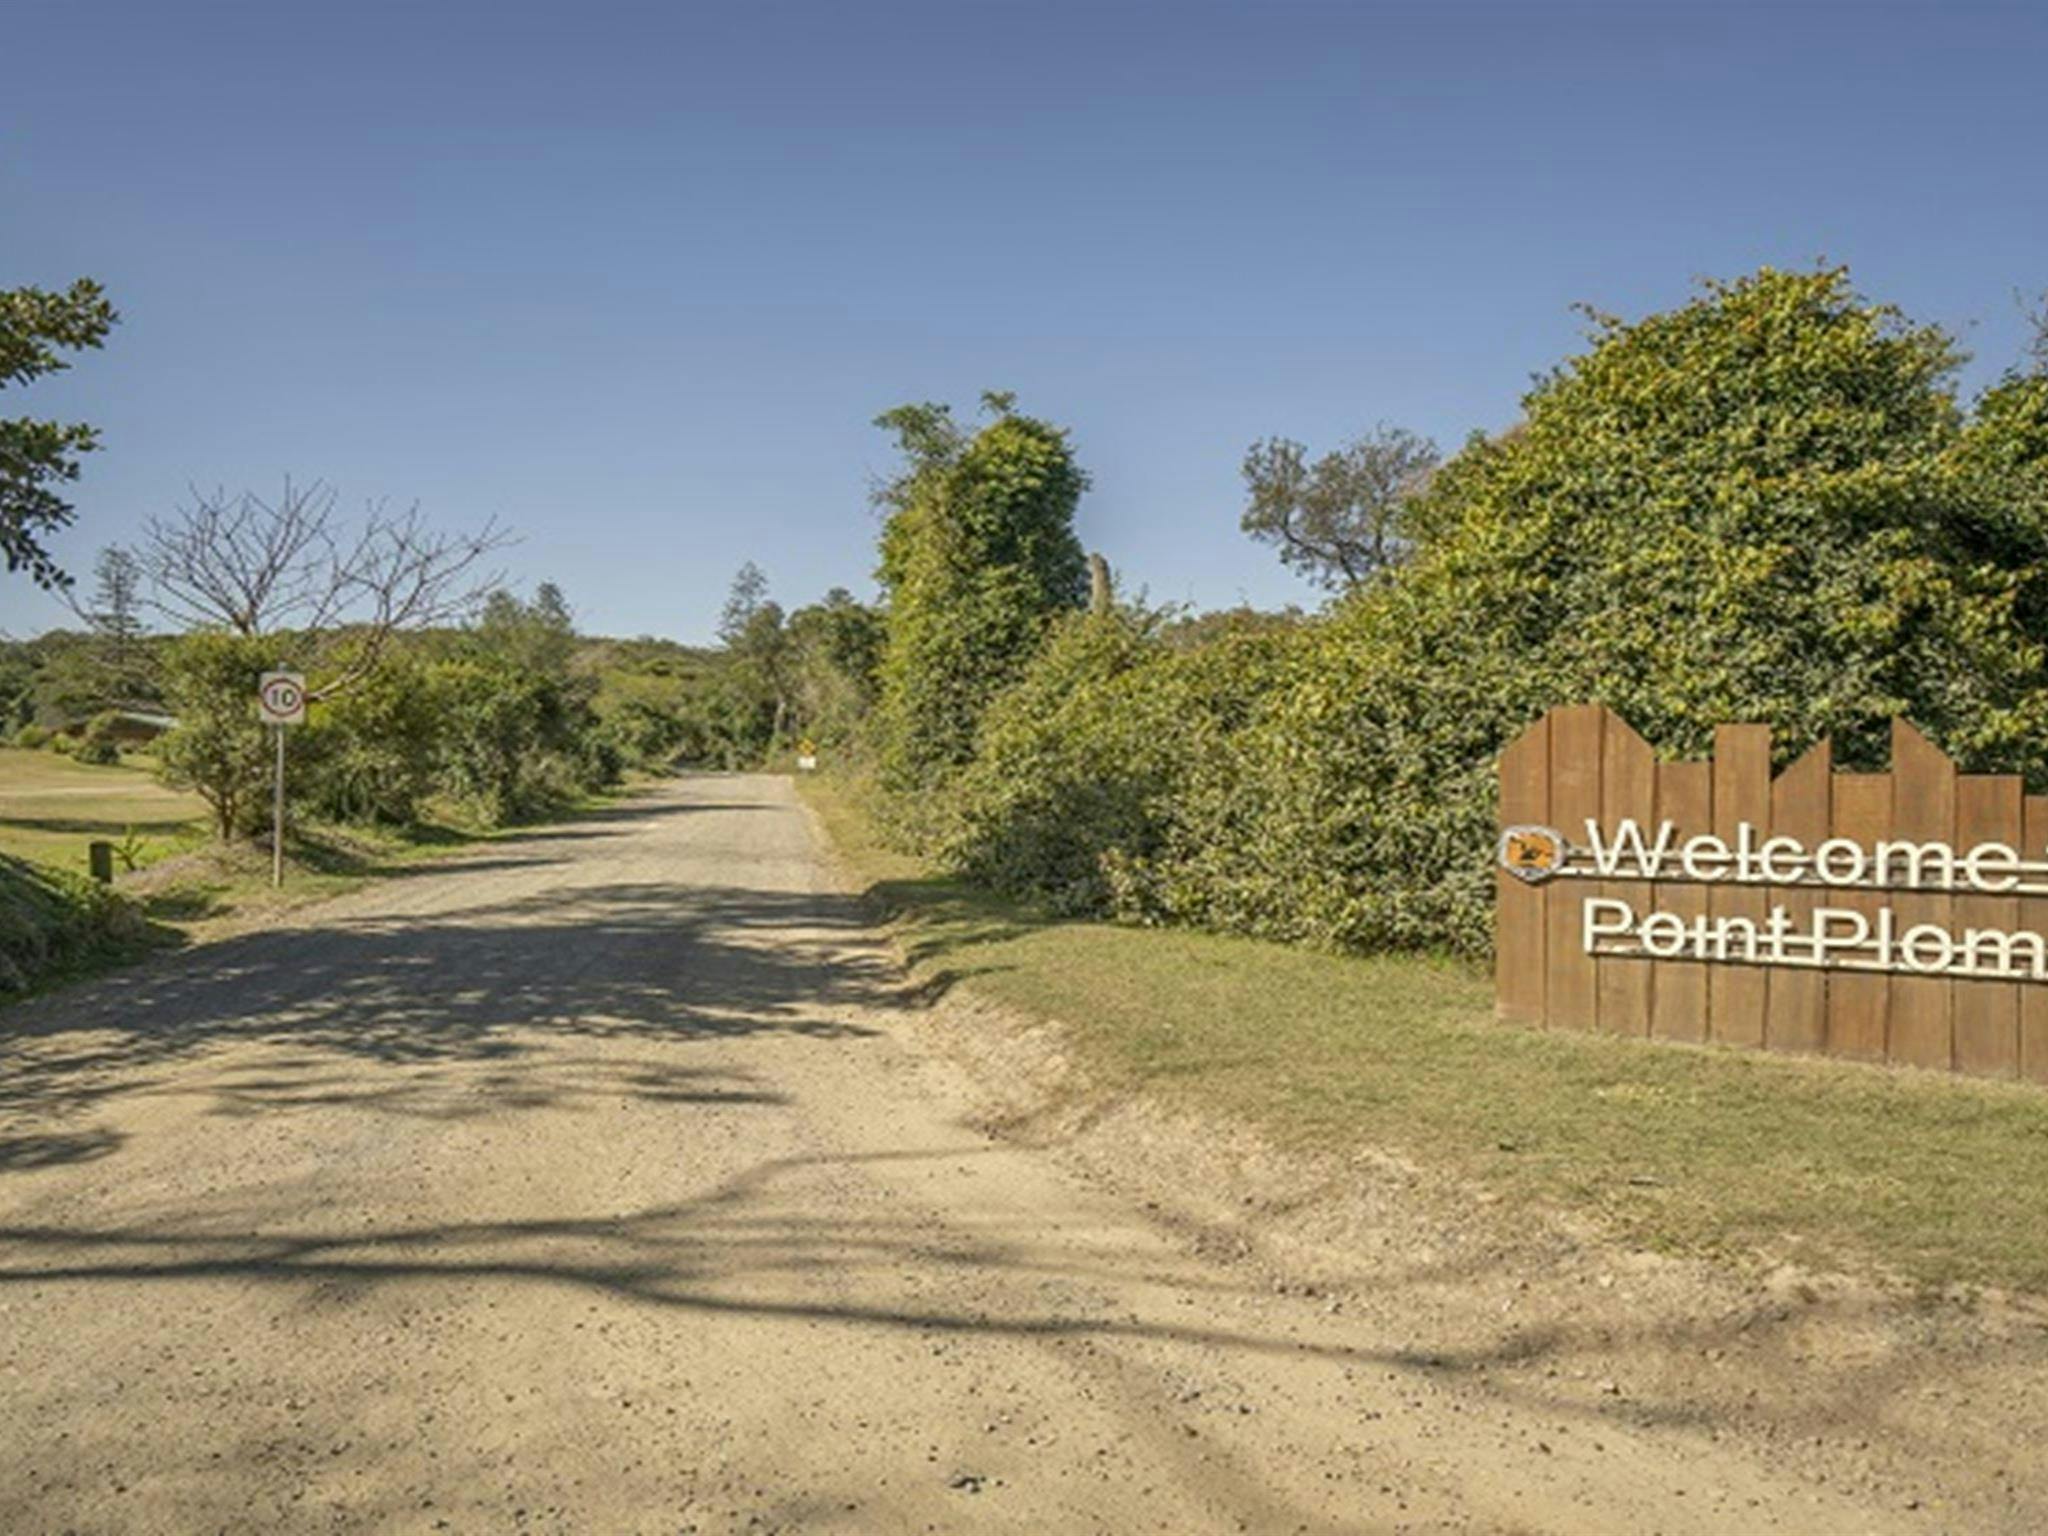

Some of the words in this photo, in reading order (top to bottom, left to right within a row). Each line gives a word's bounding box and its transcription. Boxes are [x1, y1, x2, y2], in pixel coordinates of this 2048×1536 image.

[271, 689, 297, 707] 10
[1585, 818, 2019, 891] Welcome
[1583, 898, 1793, 961] Point
[1812, 907, 2045, 978] Plom
